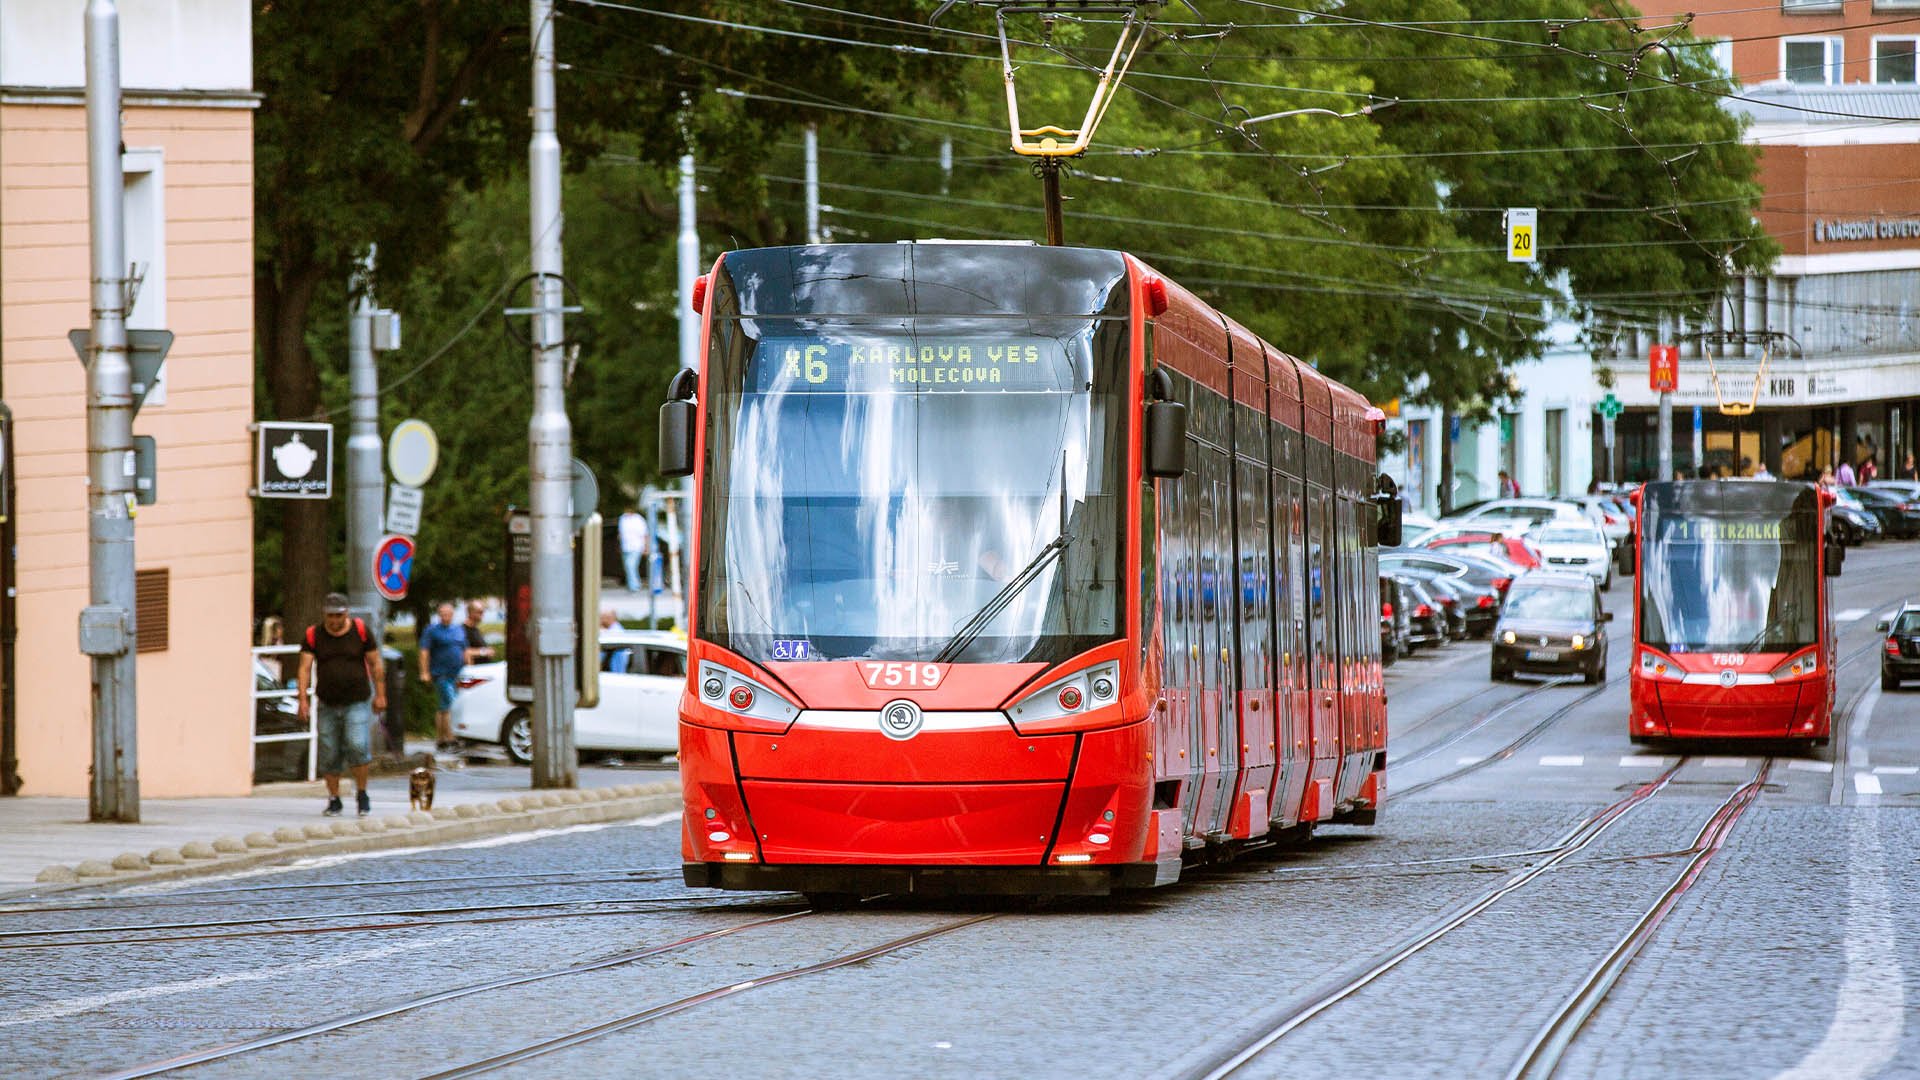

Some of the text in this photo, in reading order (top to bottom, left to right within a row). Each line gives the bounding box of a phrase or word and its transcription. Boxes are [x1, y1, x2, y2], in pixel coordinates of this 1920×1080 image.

[1514, 233, 1530, 250] 20
[852, 345, 1039, 363] KARLOVA VES
[889, 367, 1001, 383] MOLECOVA
[1770, 378, 1795, 397] KHB
[866, 663, 940, 686] 7519
